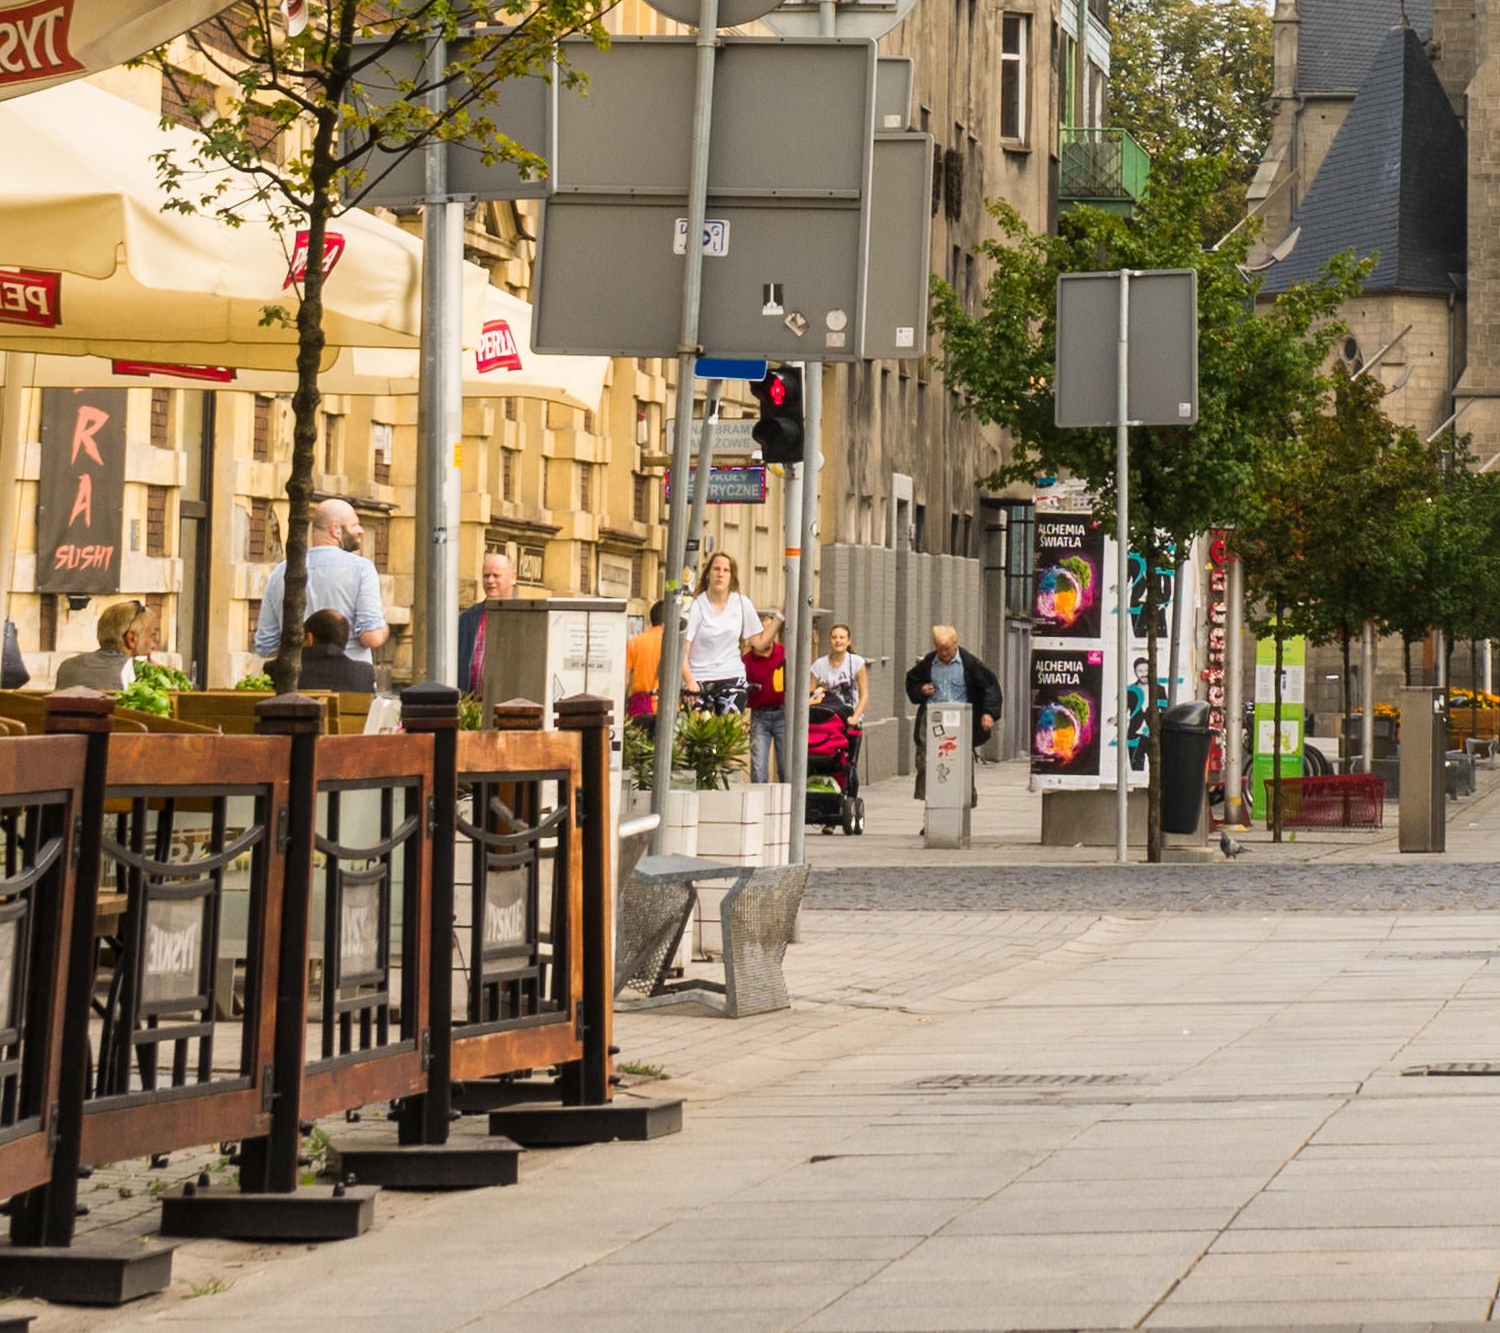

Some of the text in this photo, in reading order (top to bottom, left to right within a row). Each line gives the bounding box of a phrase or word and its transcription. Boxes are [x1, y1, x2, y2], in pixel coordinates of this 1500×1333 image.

[1038, 524, 1085, 536] ALCHEMIA
[1040, 535, 1081, 548] ŚWIATŁA
[55, 545, 114, 571] SUSHI
[1036, 660, 1084, 673] ALCHEMIA
[1038, 671, 1080, 685] ŚWIATŁA
